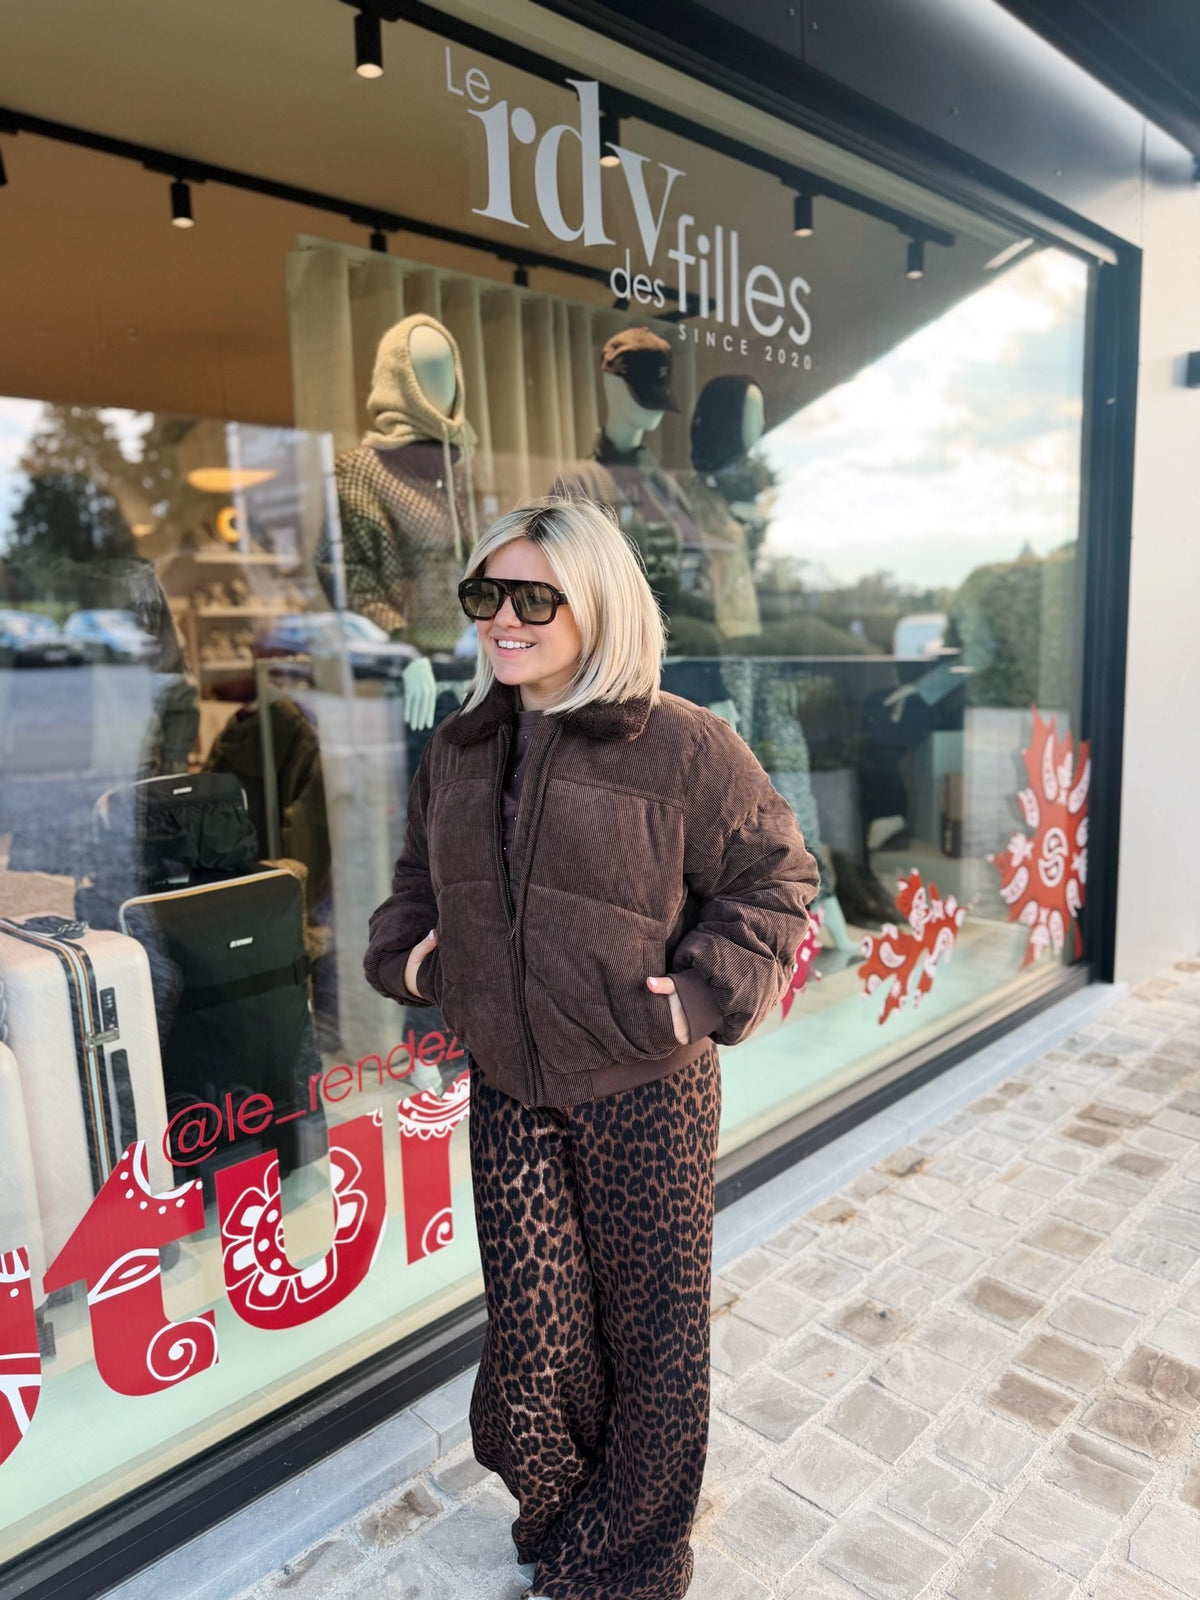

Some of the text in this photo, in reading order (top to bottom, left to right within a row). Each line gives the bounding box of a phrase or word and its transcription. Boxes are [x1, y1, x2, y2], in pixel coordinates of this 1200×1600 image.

[445, 46, 491, 104] Le
[467, 78, 687, 268] rdv
[610, 214, 812, 346] des filles
[678, 323, 813, 371] SINCE 2020
